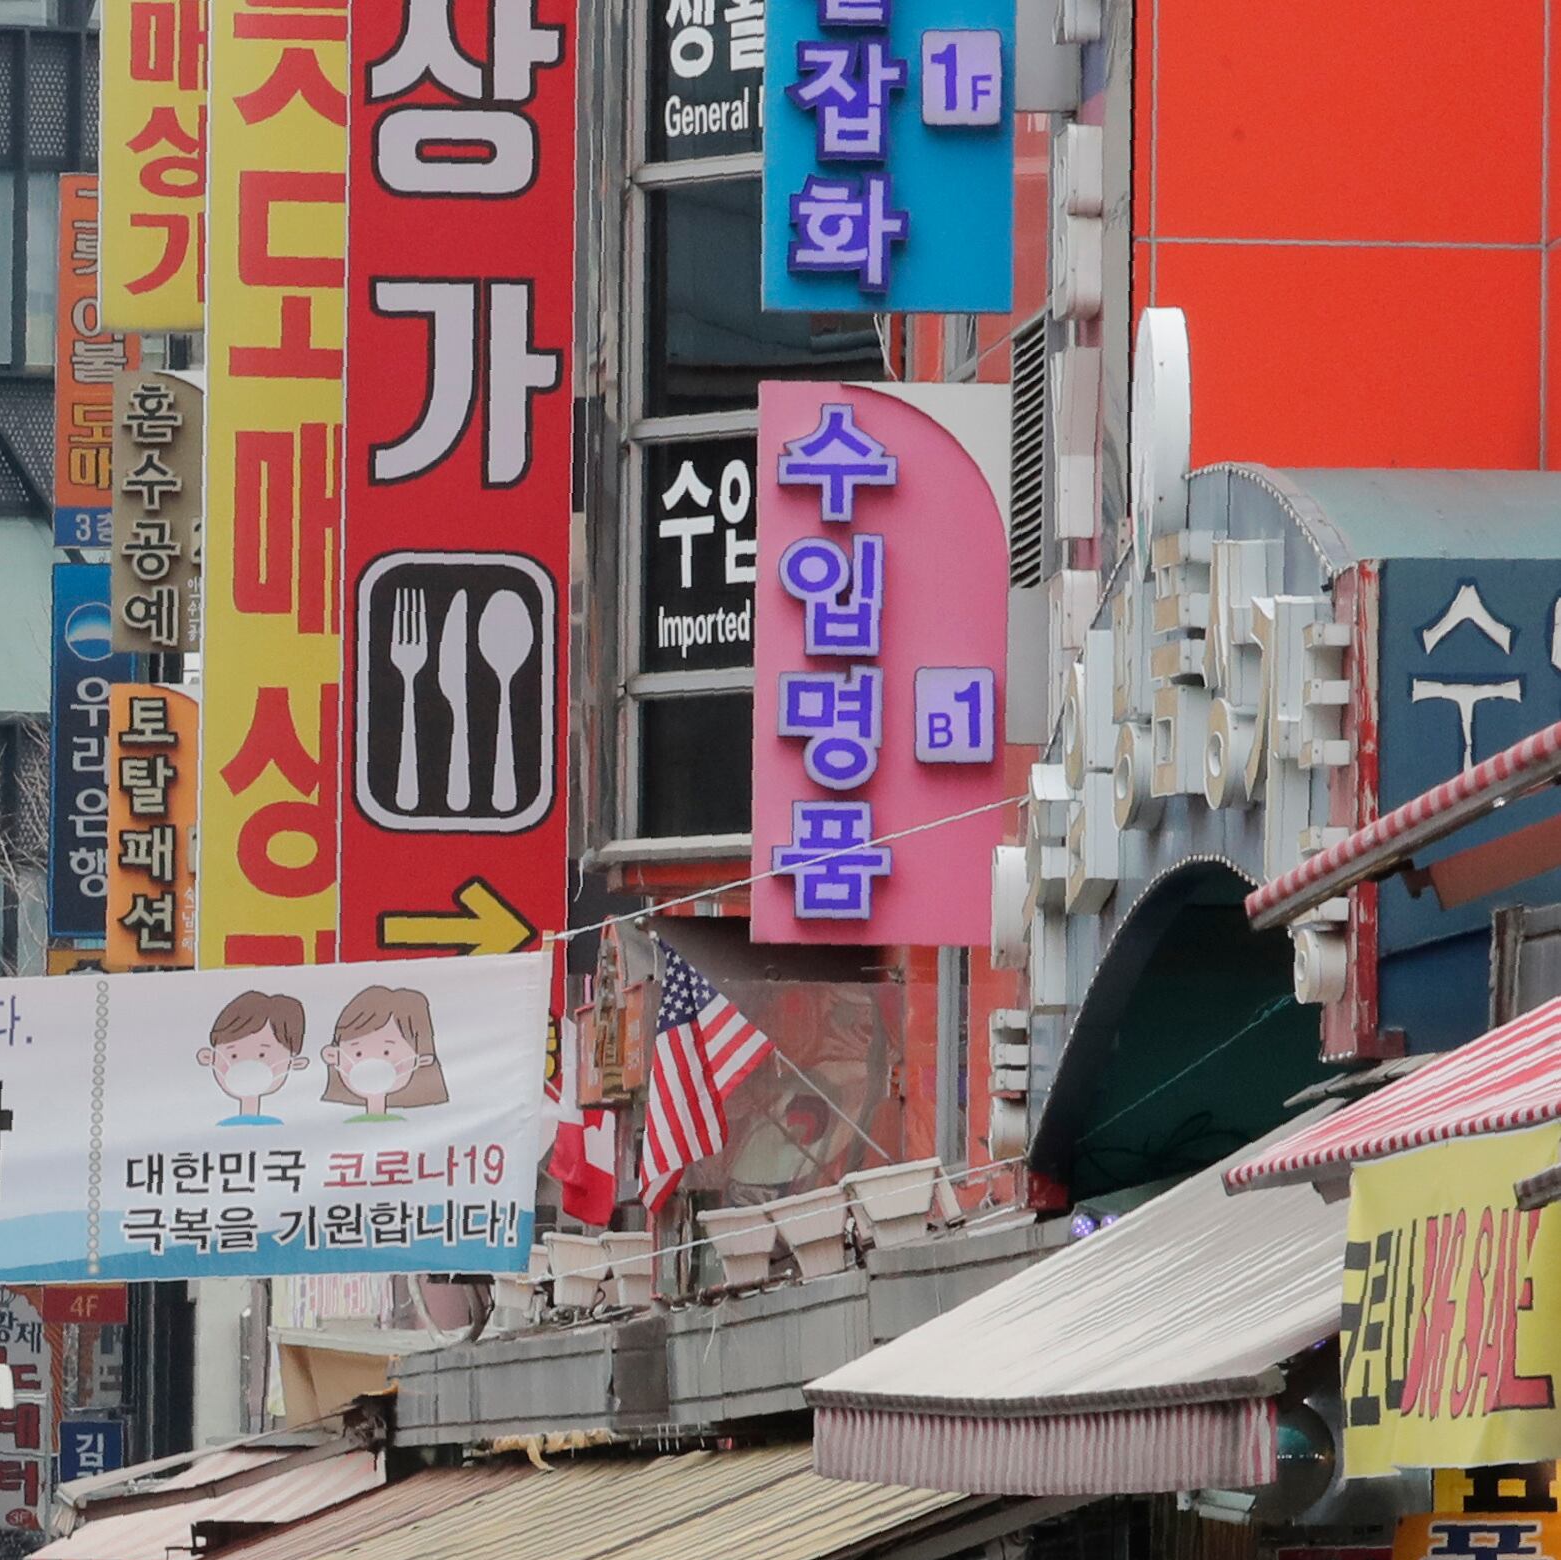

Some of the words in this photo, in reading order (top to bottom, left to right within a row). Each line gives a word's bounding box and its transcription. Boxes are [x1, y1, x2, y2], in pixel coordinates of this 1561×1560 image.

[930, 43, 992, 111] 1F
[665, 87, 751, 138] General
[791, 0, 906, 288] 잡화
[122, 383, 182, 648] 혼수공예
[658, 599, 751, 649] Imported
[777, 403, 897, 916] 수입명품
[927, 687, 983, 752] B1
[118, 696, 177, 953] 토탈패션
[126, 1150, 307, 1196] 대한민국
[323, 1144, 506, 1188] 코로나19
[123, 1205, 259, 1254] 극복을
[278, 1200, 518, 1249] 기원합니다!
[69, 1296, 99, 1318] 4F
